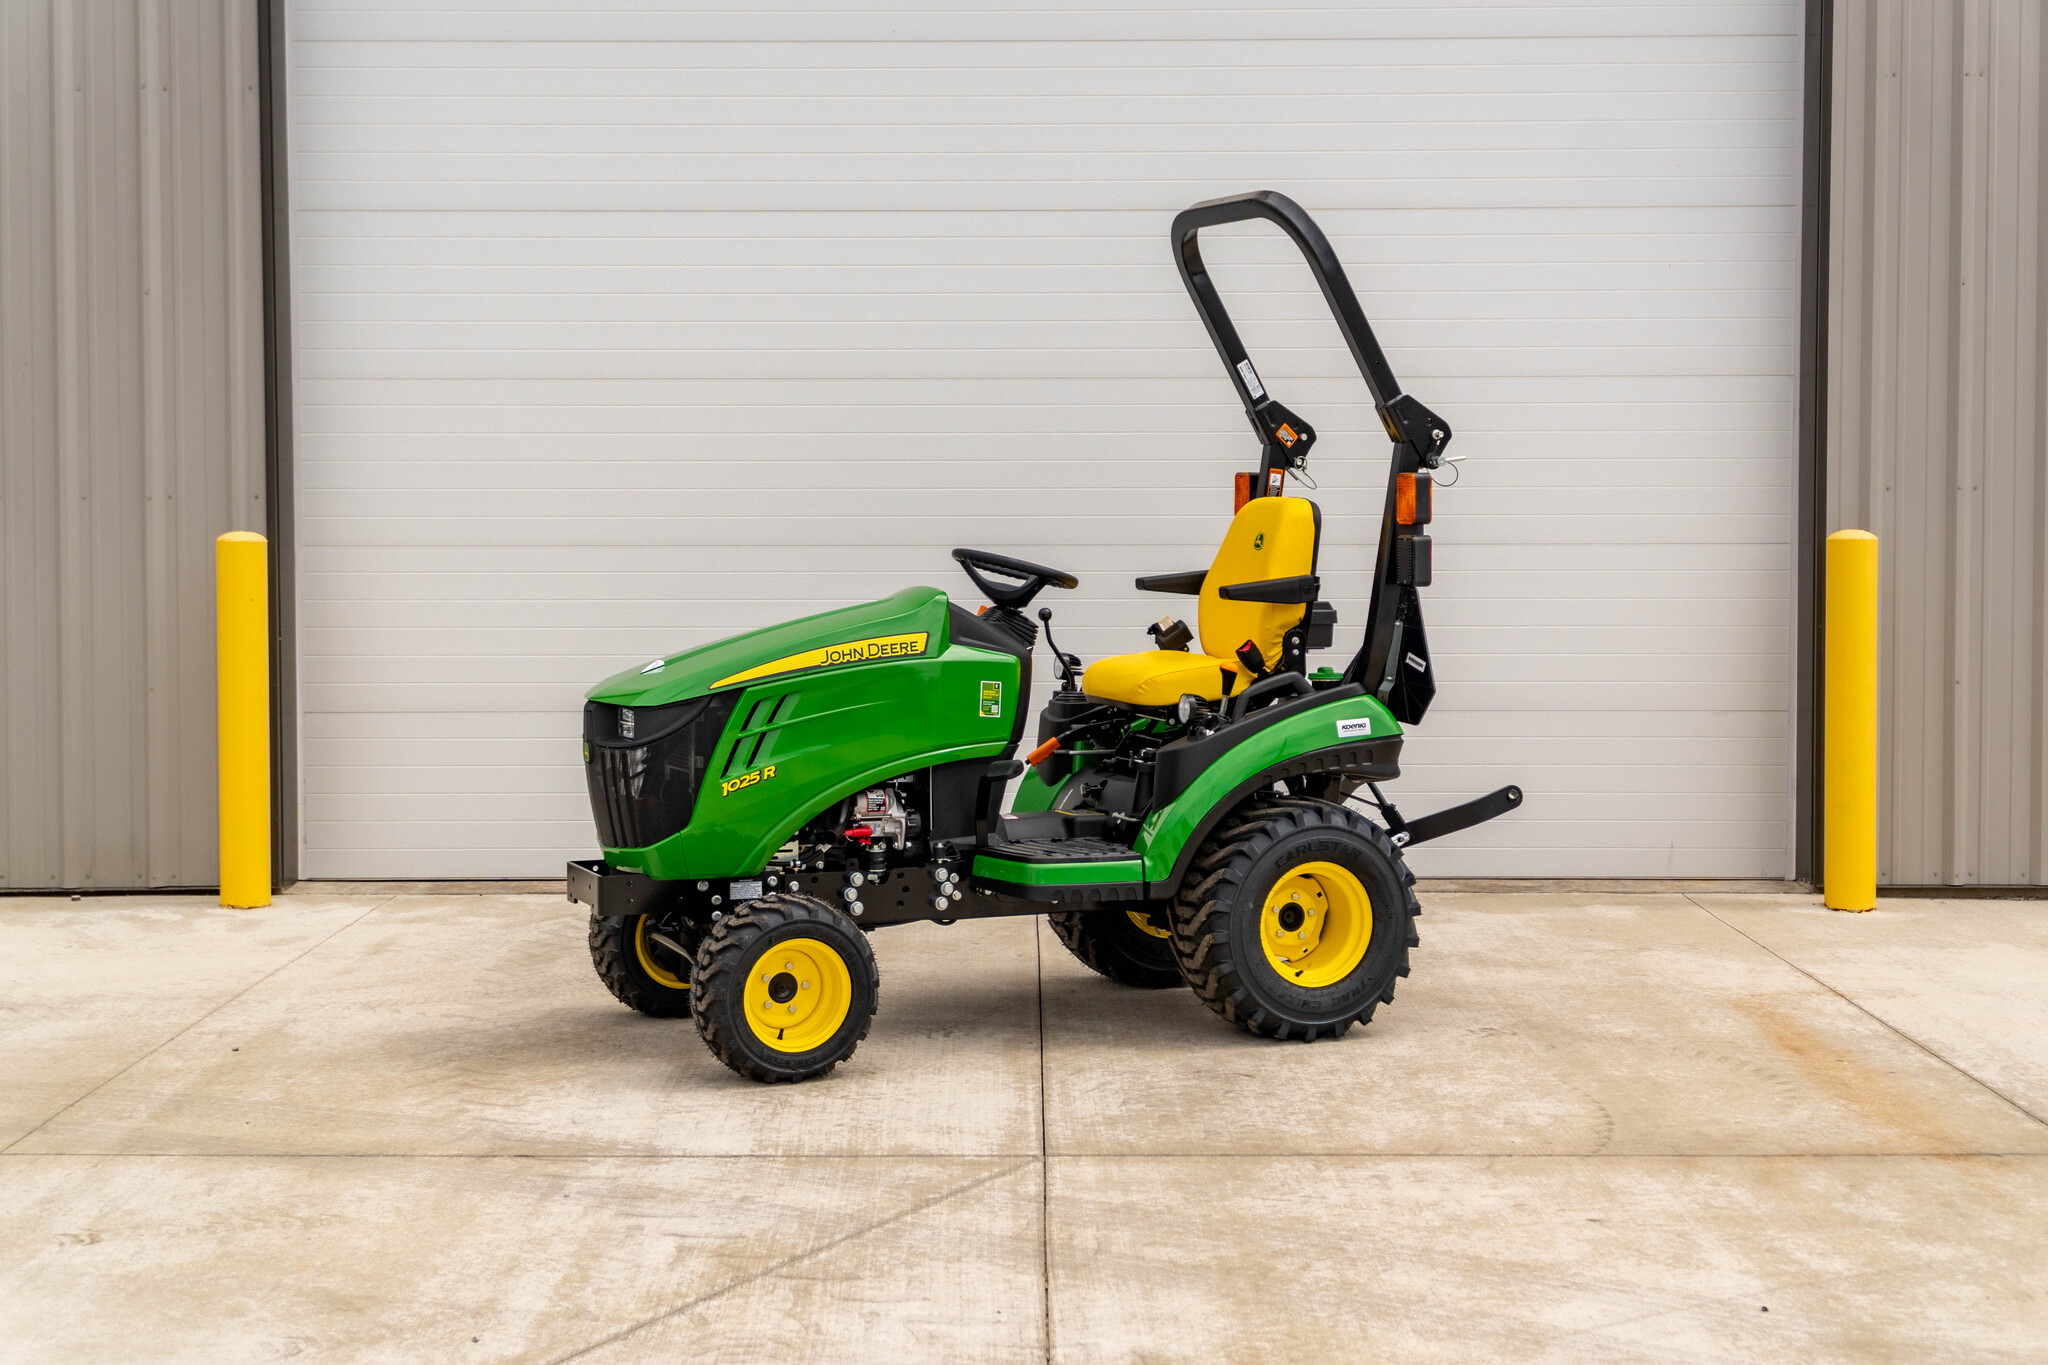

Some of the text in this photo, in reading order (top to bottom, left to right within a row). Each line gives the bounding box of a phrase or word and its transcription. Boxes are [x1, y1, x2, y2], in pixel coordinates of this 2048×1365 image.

[820, 641, 919, 665] JOHN DEERE
[721, 765, 777, 798] 1025 R
